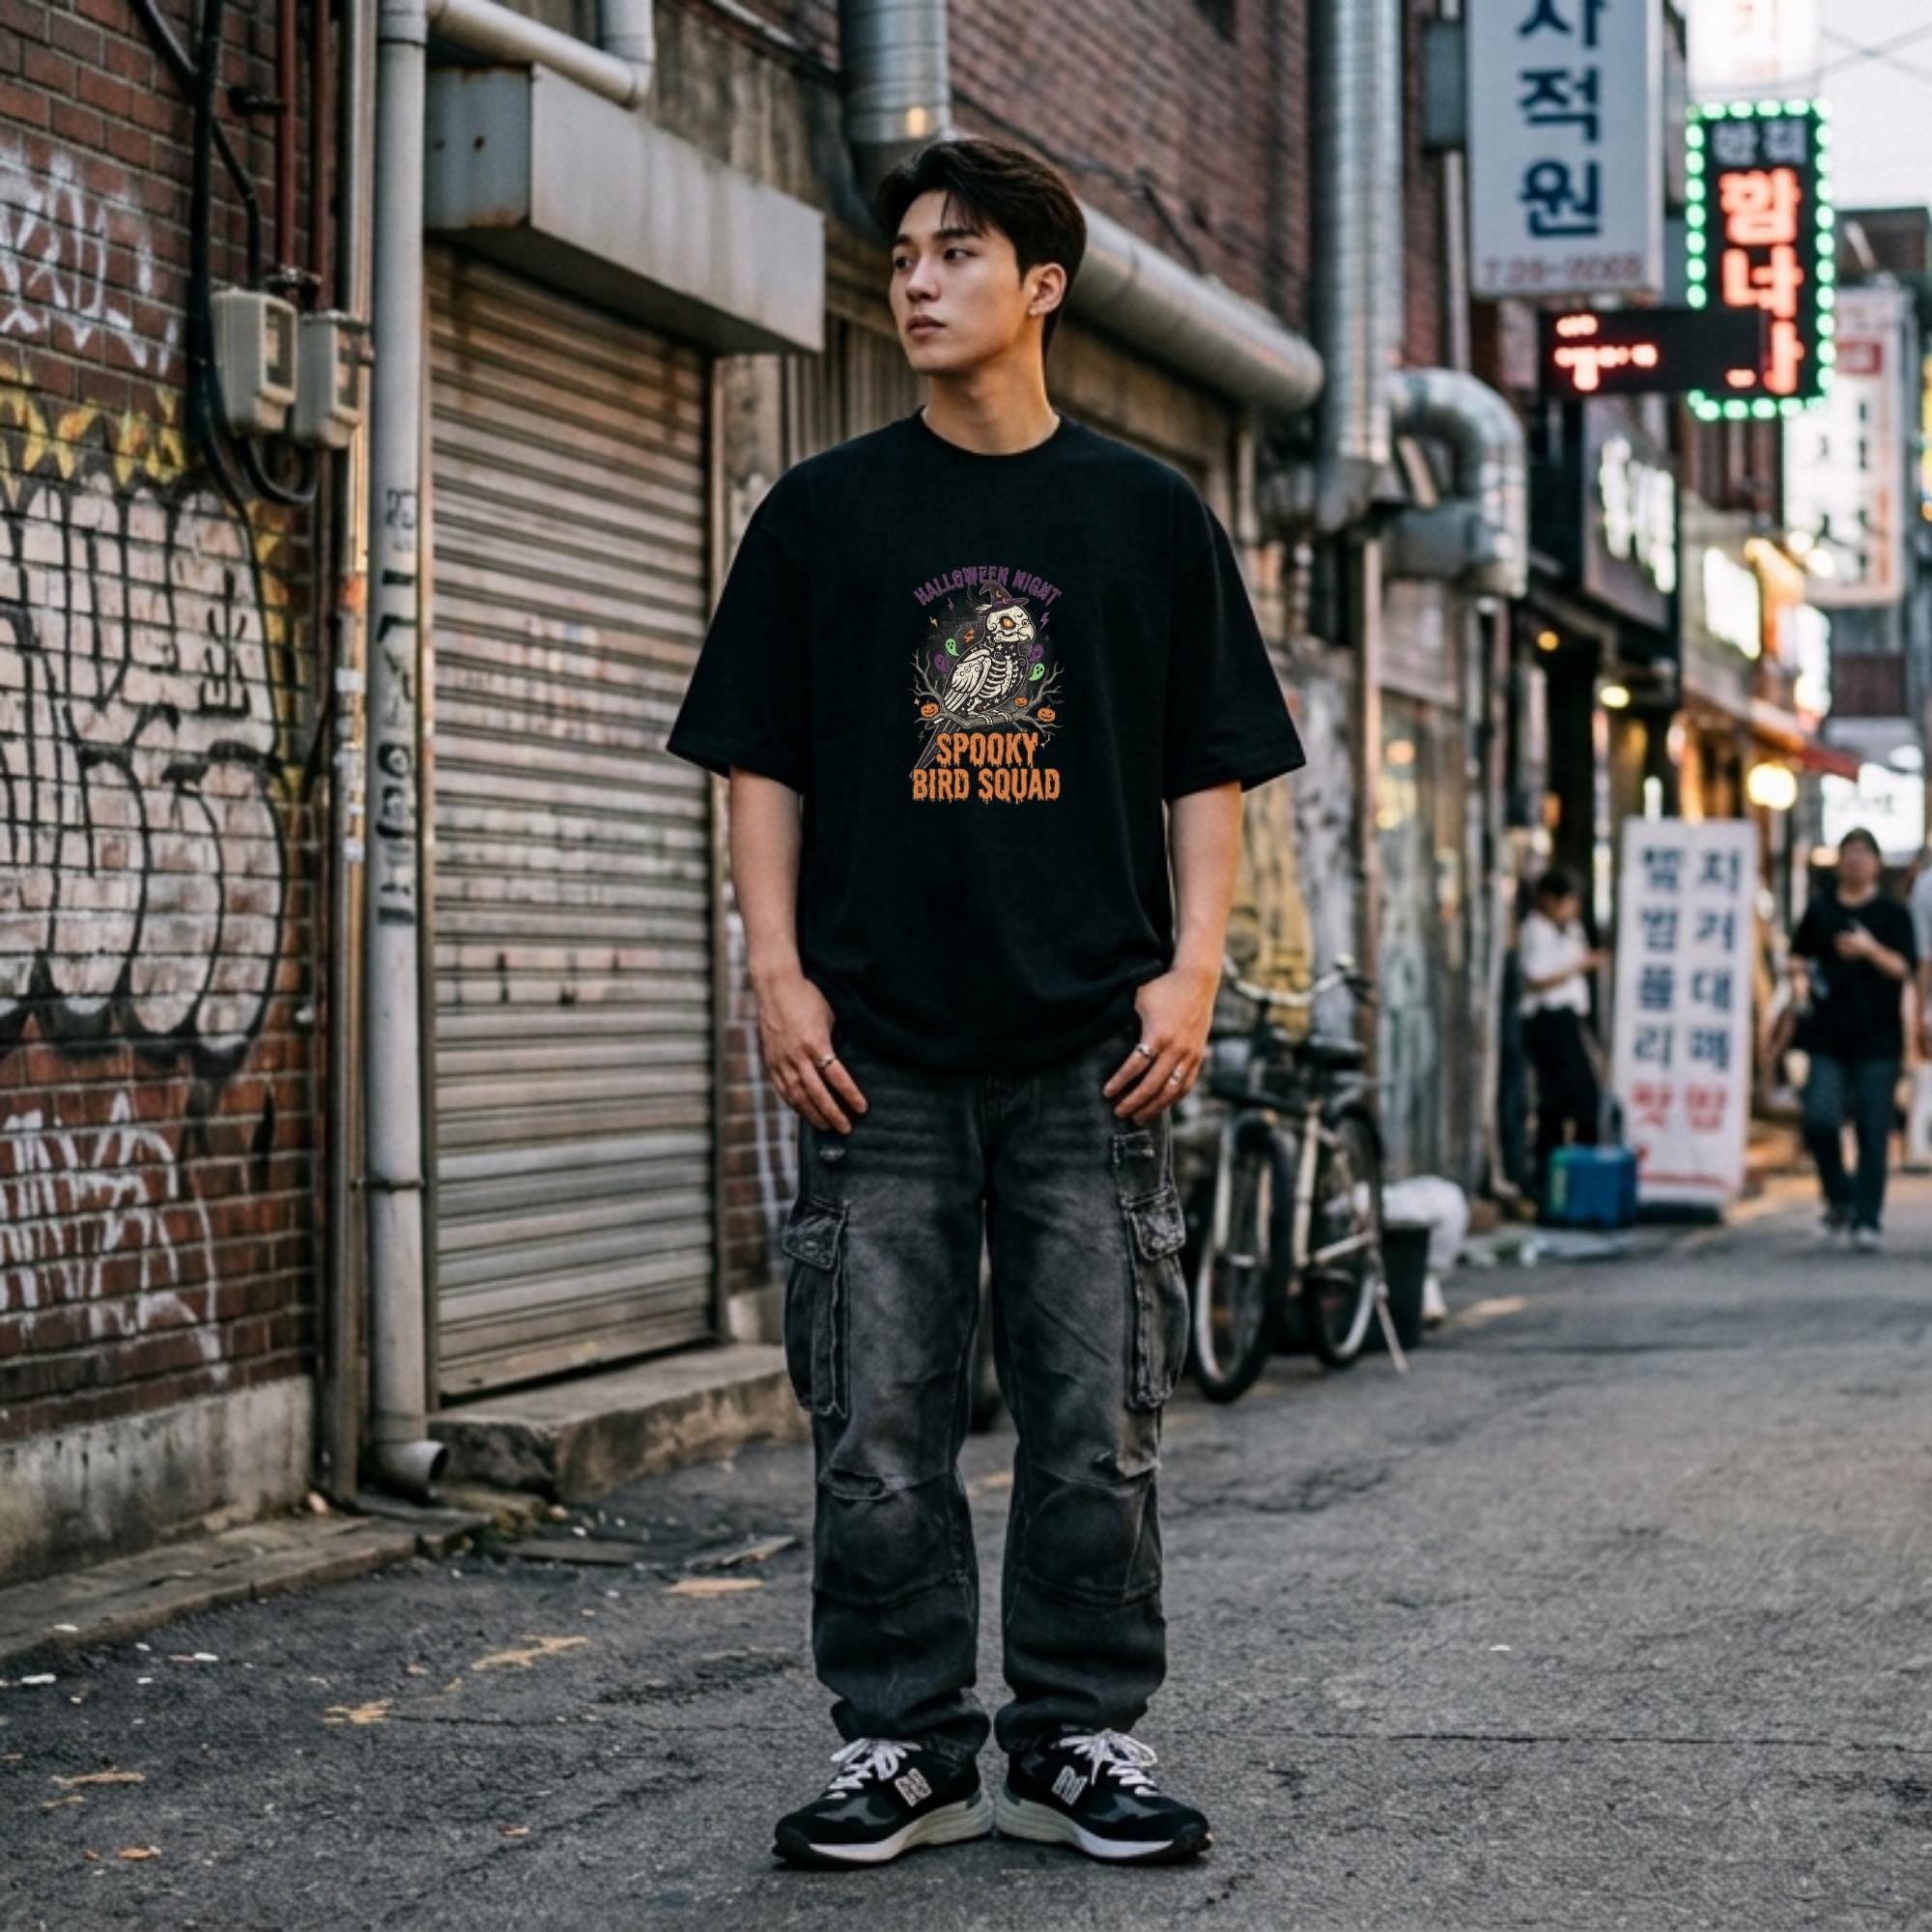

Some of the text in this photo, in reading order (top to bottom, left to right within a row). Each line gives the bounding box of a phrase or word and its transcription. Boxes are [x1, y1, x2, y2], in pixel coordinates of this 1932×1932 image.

[913, 565, 1062, 607] HALLOWEEN NIGHT
[935, 731, 1039, 768] SPOOKY
[911, 768, 1061, 804] BIRD SQUAD
